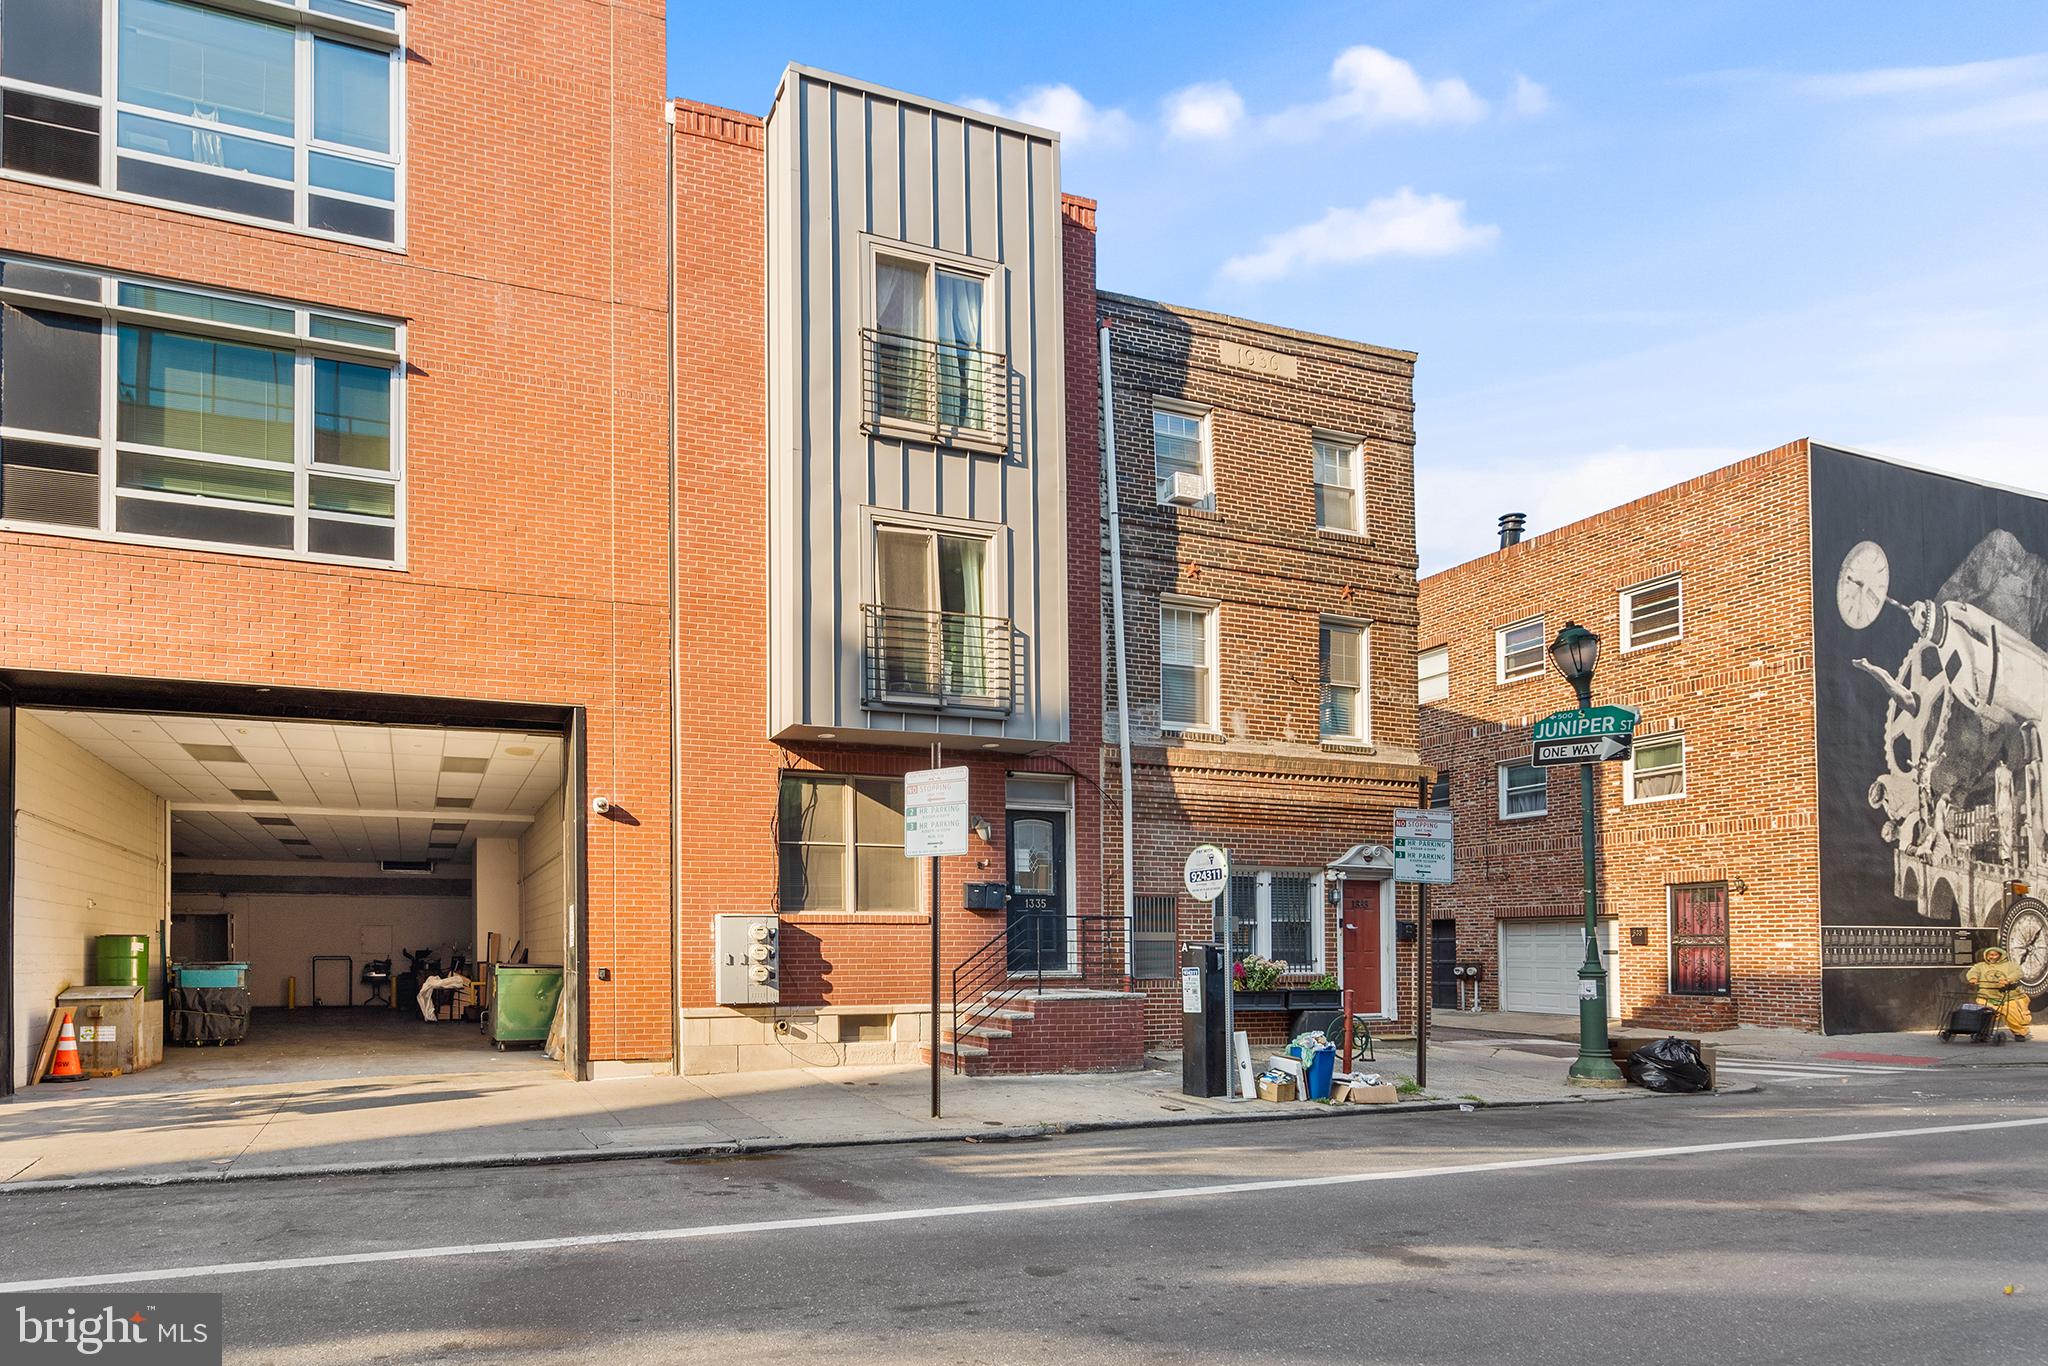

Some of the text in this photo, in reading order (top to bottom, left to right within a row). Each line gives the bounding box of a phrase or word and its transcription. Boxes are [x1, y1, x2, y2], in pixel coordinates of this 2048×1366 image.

[1237, 347, 1280, 371] 1936
[1578, 710, 1585, 719] S
[1535, 716, 1634, 739] JUNIPER ST
[1542, 743, 1600, 758] ONE WAY
[919, 783, 953, 793] STOPPING
[931, 805, 960, 814] PARKING
[931, 820, 960, 829] PARKING
[1408, 821, 1439, 829] STOPPING
[1418, 840, 1446, 849] PARKING
[1418, 853, 1446, 861] PARKING
[1190, 869, 1221, 882] 924311
[1025, 898, 1047, 909] 1335
[1181, 942, 1188, 952] A
